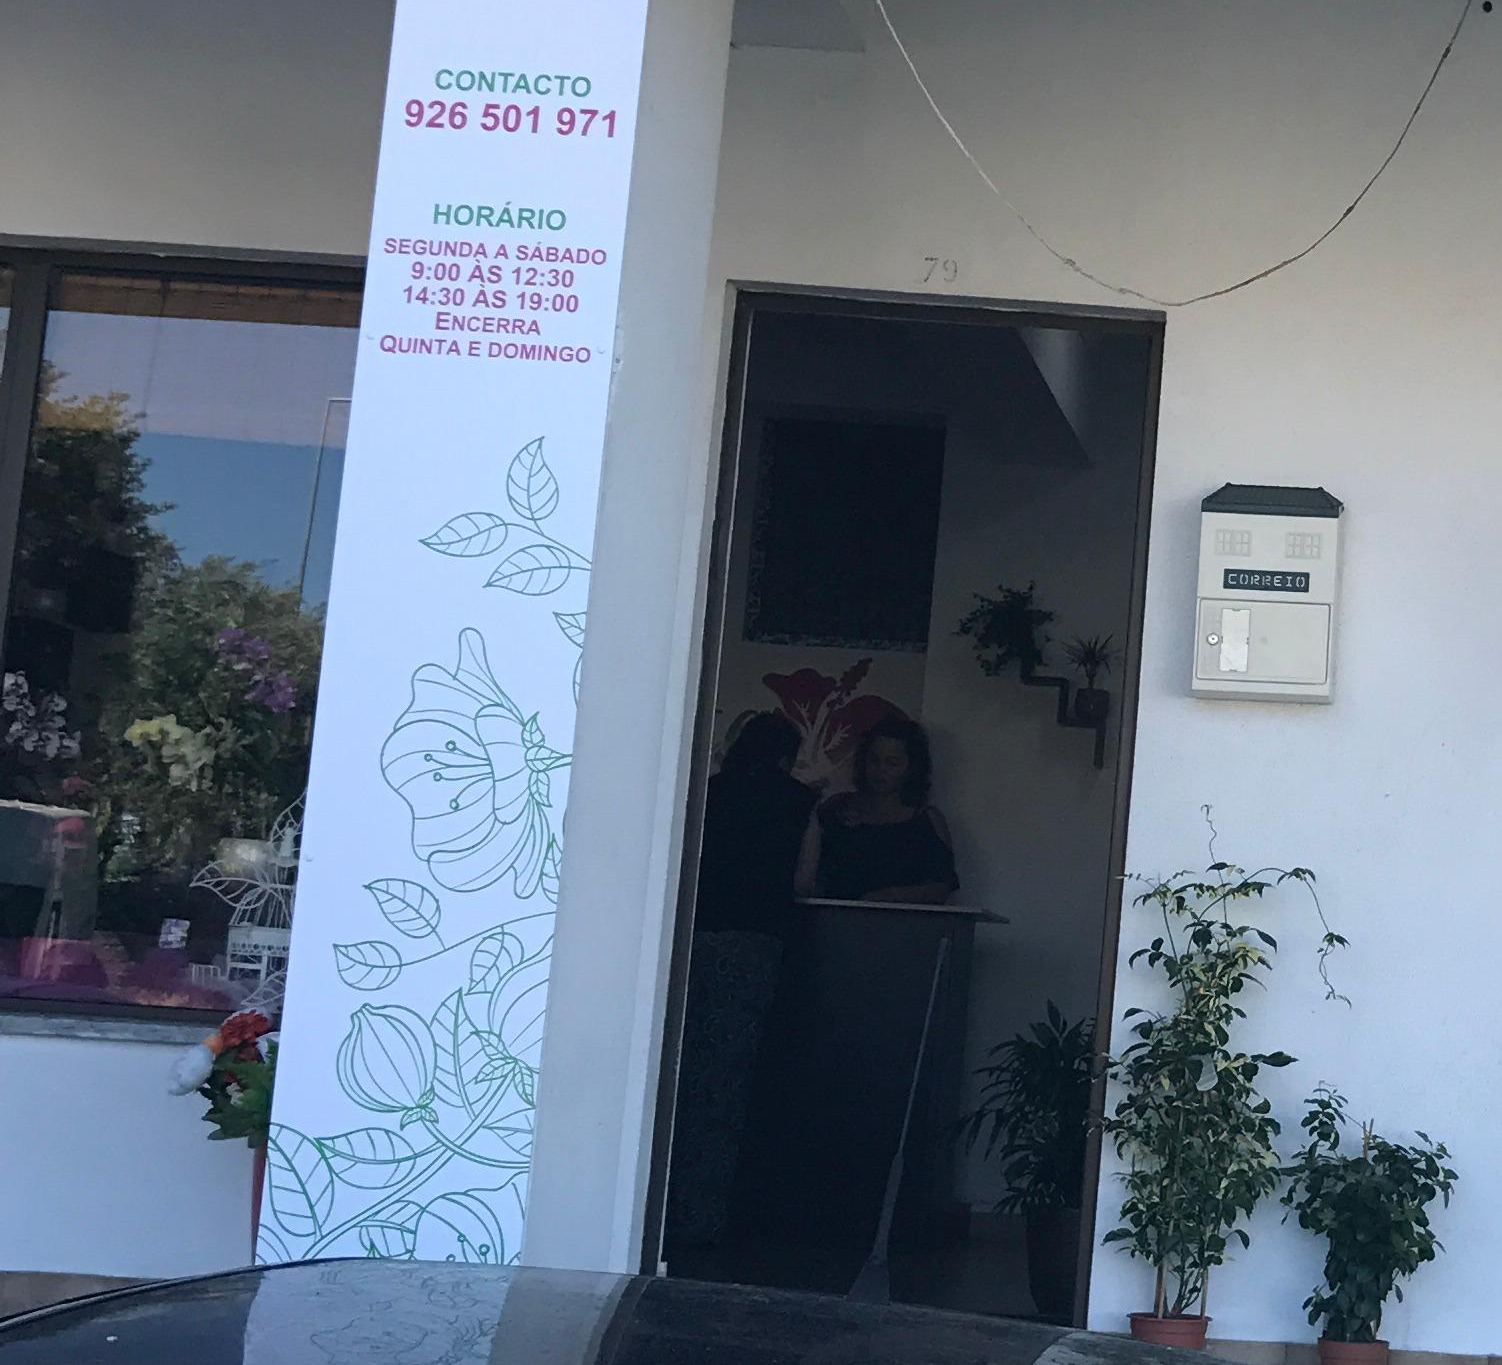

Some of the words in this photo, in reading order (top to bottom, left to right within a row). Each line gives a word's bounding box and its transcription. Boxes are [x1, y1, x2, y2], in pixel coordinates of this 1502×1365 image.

[434, 68, 592, 98] CONTACTO
[404, 98, 469, 130] 926
[479, 102, 541, 134] 501
[555, 106, 617, 139] 971
[432, 201, 567, 231] HORÁRIO
[383, 237, 489, 260] SEGUNDA
[493, 243, 510, 260] A
[515, 241, 608, 266] SÁBADO
[410, 260, 461, 282] 9:00
[467, 259, 503, 285] ÀS
[511, 266, 575, 289] 12:30
[923, 256, 958, 283] 79
[402, 284, 466, 307] 14:30
[471, 283, 507, 309] ÀS
[516, 291, 579, 314] 19:00
[434, 311, 541, 336] ENCERRA
[379, 334, 461, 357] QUINTA
[467, 340, 482, 358] E
[487, 341, 592, 364] DOMINGO
[1227, 573, 1306, 588] CORREIO
